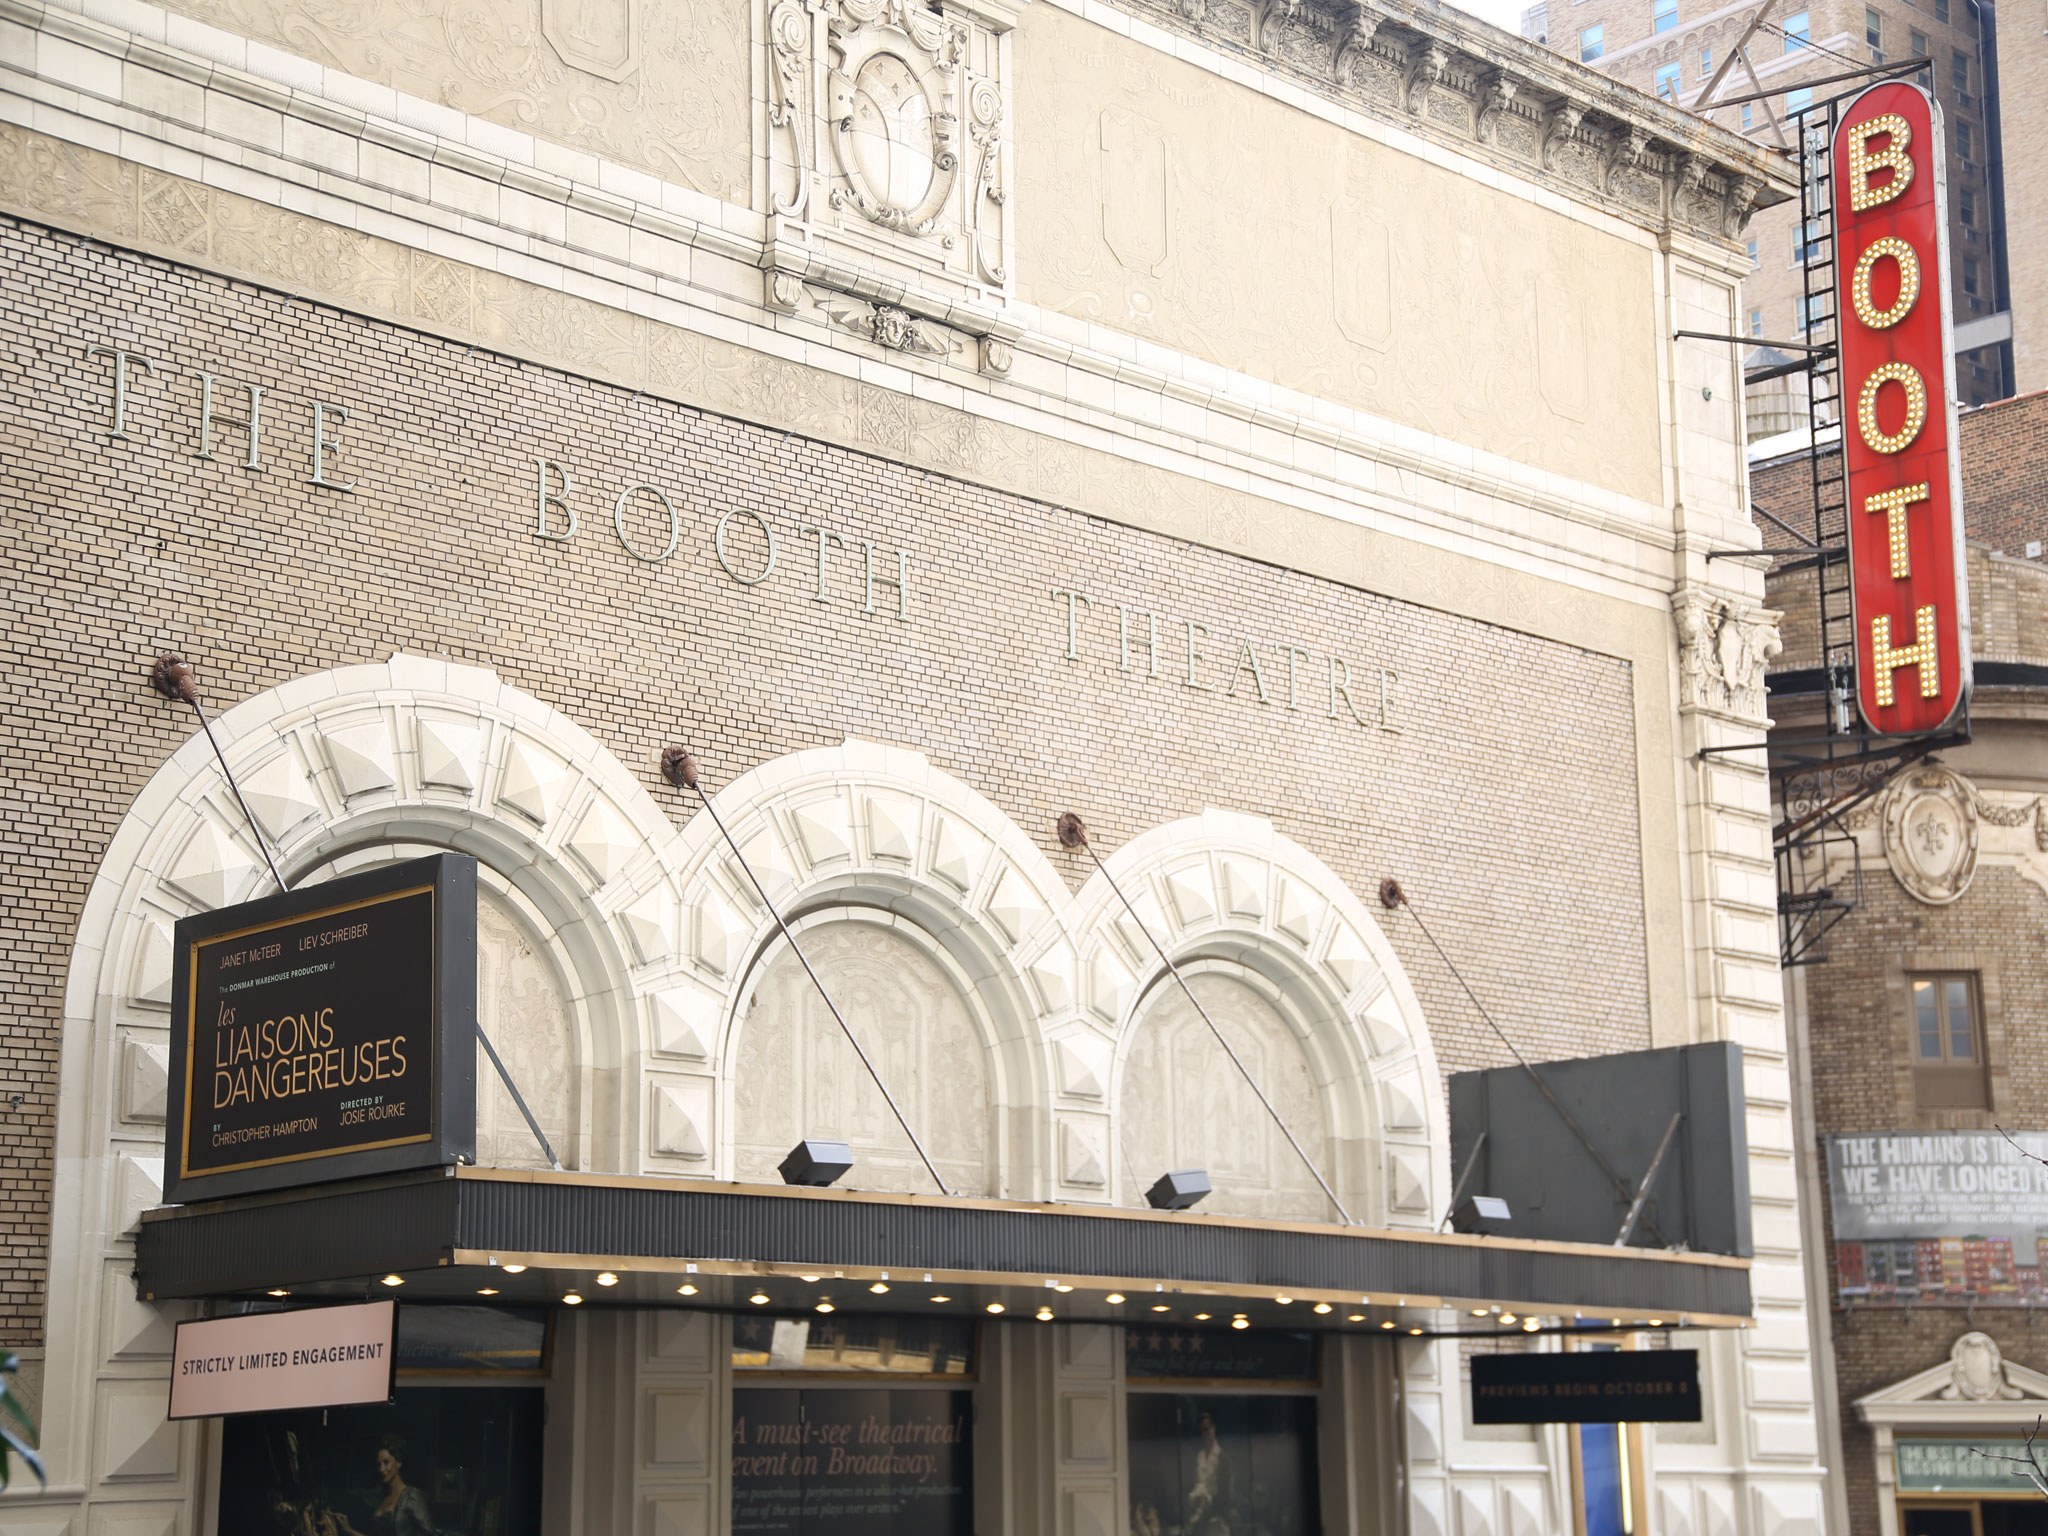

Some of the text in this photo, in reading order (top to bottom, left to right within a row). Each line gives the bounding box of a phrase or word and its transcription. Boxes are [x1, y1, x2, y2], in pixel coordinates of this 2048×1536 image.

[1847, 112, 1940, 706] BOOTH
[86, 342, 1408, 734] THE BOOTH THEATRE
[299, 923, 368, 951] LIEV SCHREIBER
[220, 943, 281, 970] JANET McTEER
[219, 961, 336, 994] The DONMAR WAREHOUSE PRODUCTION of
[217, 1001, 235, 1027] les
[215, 1008, 334, 1068] LIAISONS
[213, 1035, 407, 1109] DANGEREUSES
[340, 1095, 384, 1110] DIRECTED BY
[340, 1102, 406, 1126] JOSIE ROURKE
[212, 1123, 221, 1132] BY
[212, 1117, 318, 1147] CHRISTOPHER HAMPTON
[1970, 1136, 1989, 1164] IS
[1842, 1166, 1883, 1194] WE
[1889, 1165, 1944, 1193] HAVE
[1951, 1165, 2031, 1193] LONGED
[182, 1356, 235, 1375] STRICTLY
[239, 1351, 288, 1370] LIMITED
[292, 1342, 384, 1366] ENGAGEMENT
[1479, 1383, 1550, 1397] PREVIEWS
[1554, 1382, 1599, 1397] BEGIN
[1604, 1381, 1674, 1395] OCTOBER
[732, 1415, 964, 1445] A must-see theatrical
[732, 1446, 938, 1483] event on Broadway.
